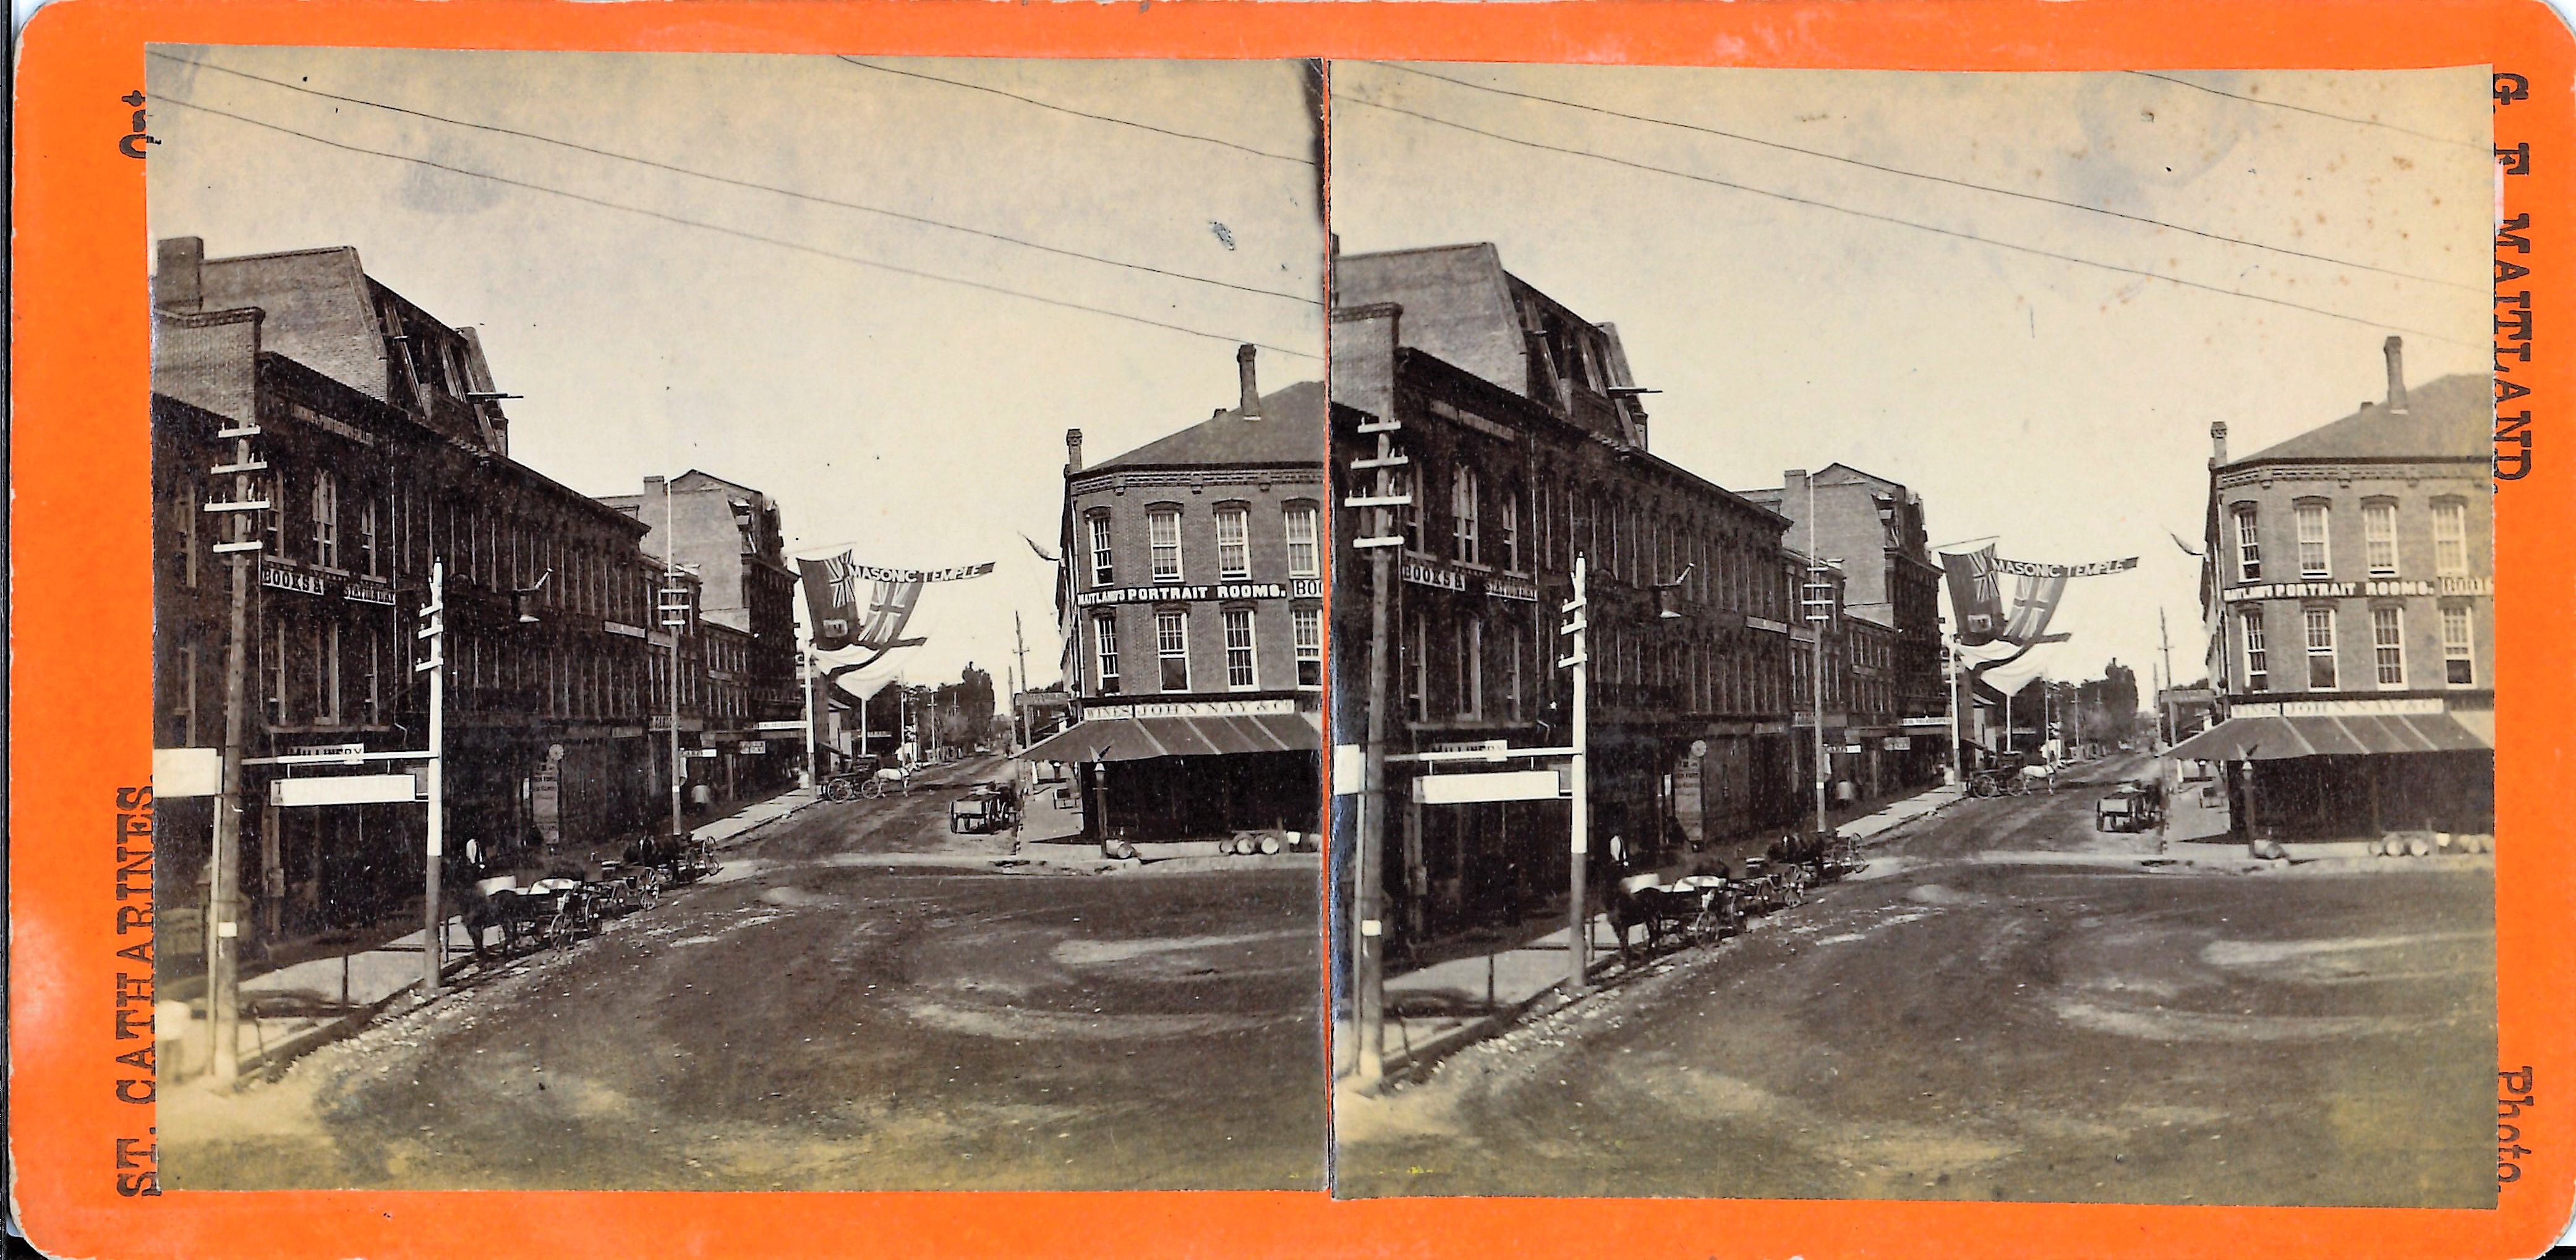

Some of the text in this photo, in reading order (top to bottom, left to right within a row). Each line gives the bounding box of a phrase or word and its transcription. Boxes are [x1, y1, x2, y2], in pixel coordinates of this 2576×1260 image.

[921, 564, 983, 582] TEMPLE
[1401, 564, 1450, 586] BOOKS
[2066, 560, 2126, 577] TEMPLE
[262, 569, 310, 591] BOOKS
[1127, 586, 1208, 600] PORTRAIT
[1217, 584, 1287, 598] ROOMS.
[2275, 582, 2356, 597] PORTRAIT
[2365, 581, 2434, 595] ROOMS.
[1137, 704, 1198, 716] JOHN
